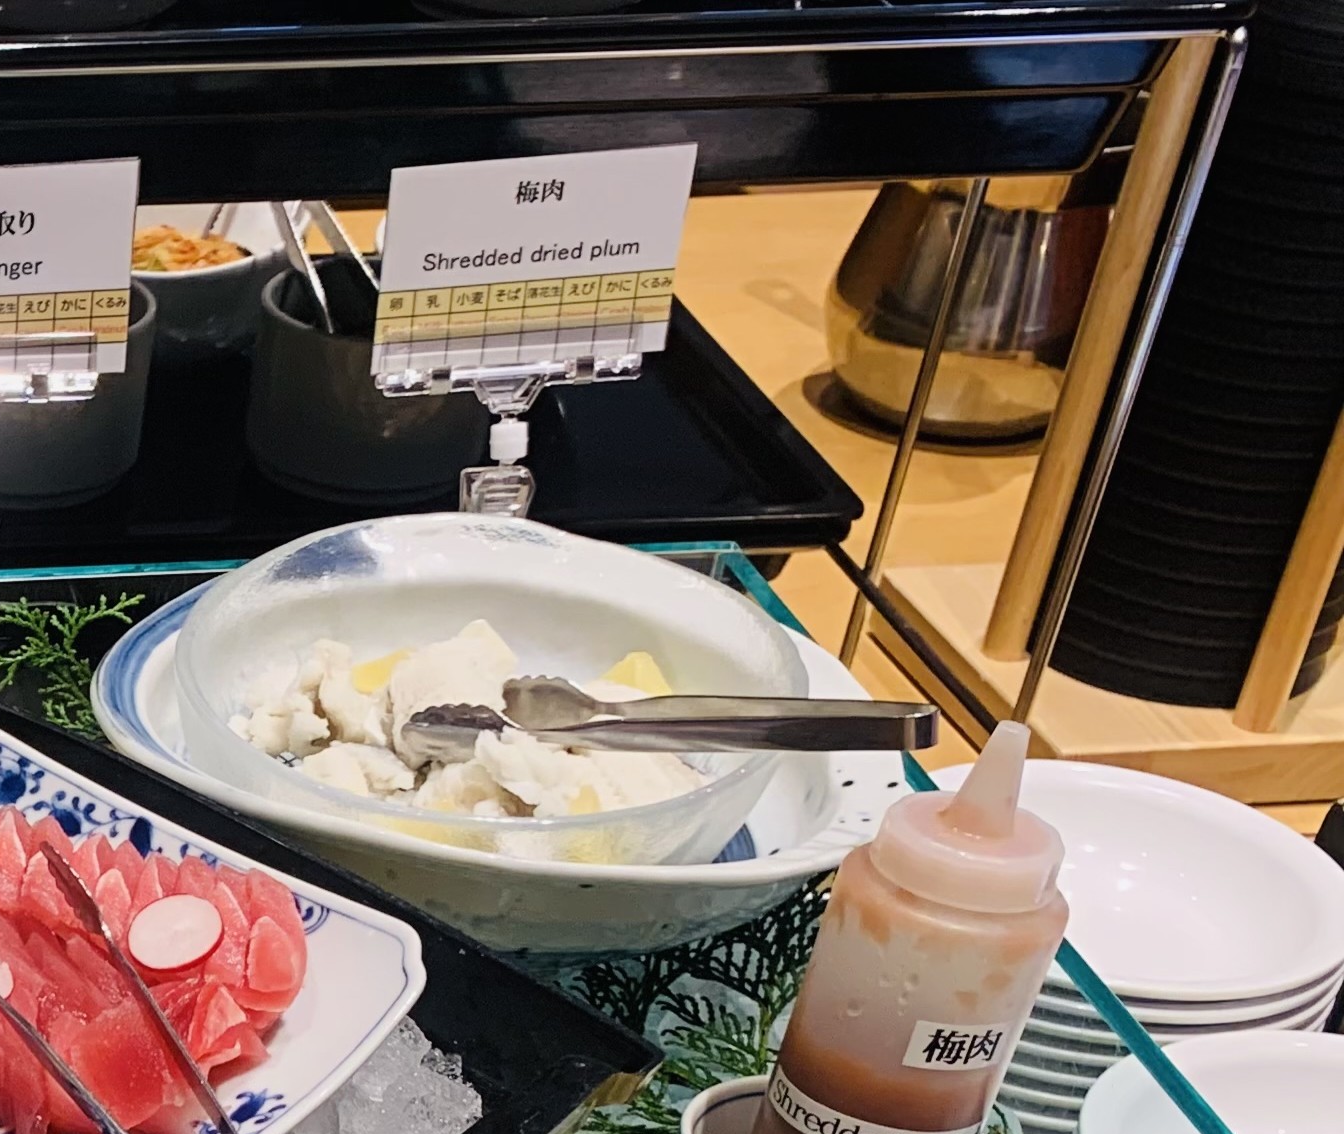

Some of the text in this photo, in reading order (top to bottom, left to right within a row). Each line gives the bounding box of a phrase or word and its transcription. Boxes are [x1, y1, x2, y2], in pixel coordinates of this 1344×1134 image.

[515, 180, 565, 205] 梅肉
[422, 239, 640, 271] Shredded dried plum
[24, 300, 50, 313] えび
[61, 299, 86, 311] かに
[95, 297, 126, 309] くるみ
[426, 295, 440, 308] 乳
[456, 292, 484, 305] 小麦
[496, 288, 521, 301] そば
[569, 283, 595, 296] えび
[606, 280, 631, 293] かに
[640, 277, 672, 289] くるみ
[923, 1029, 1003, 1064] 梅肉
